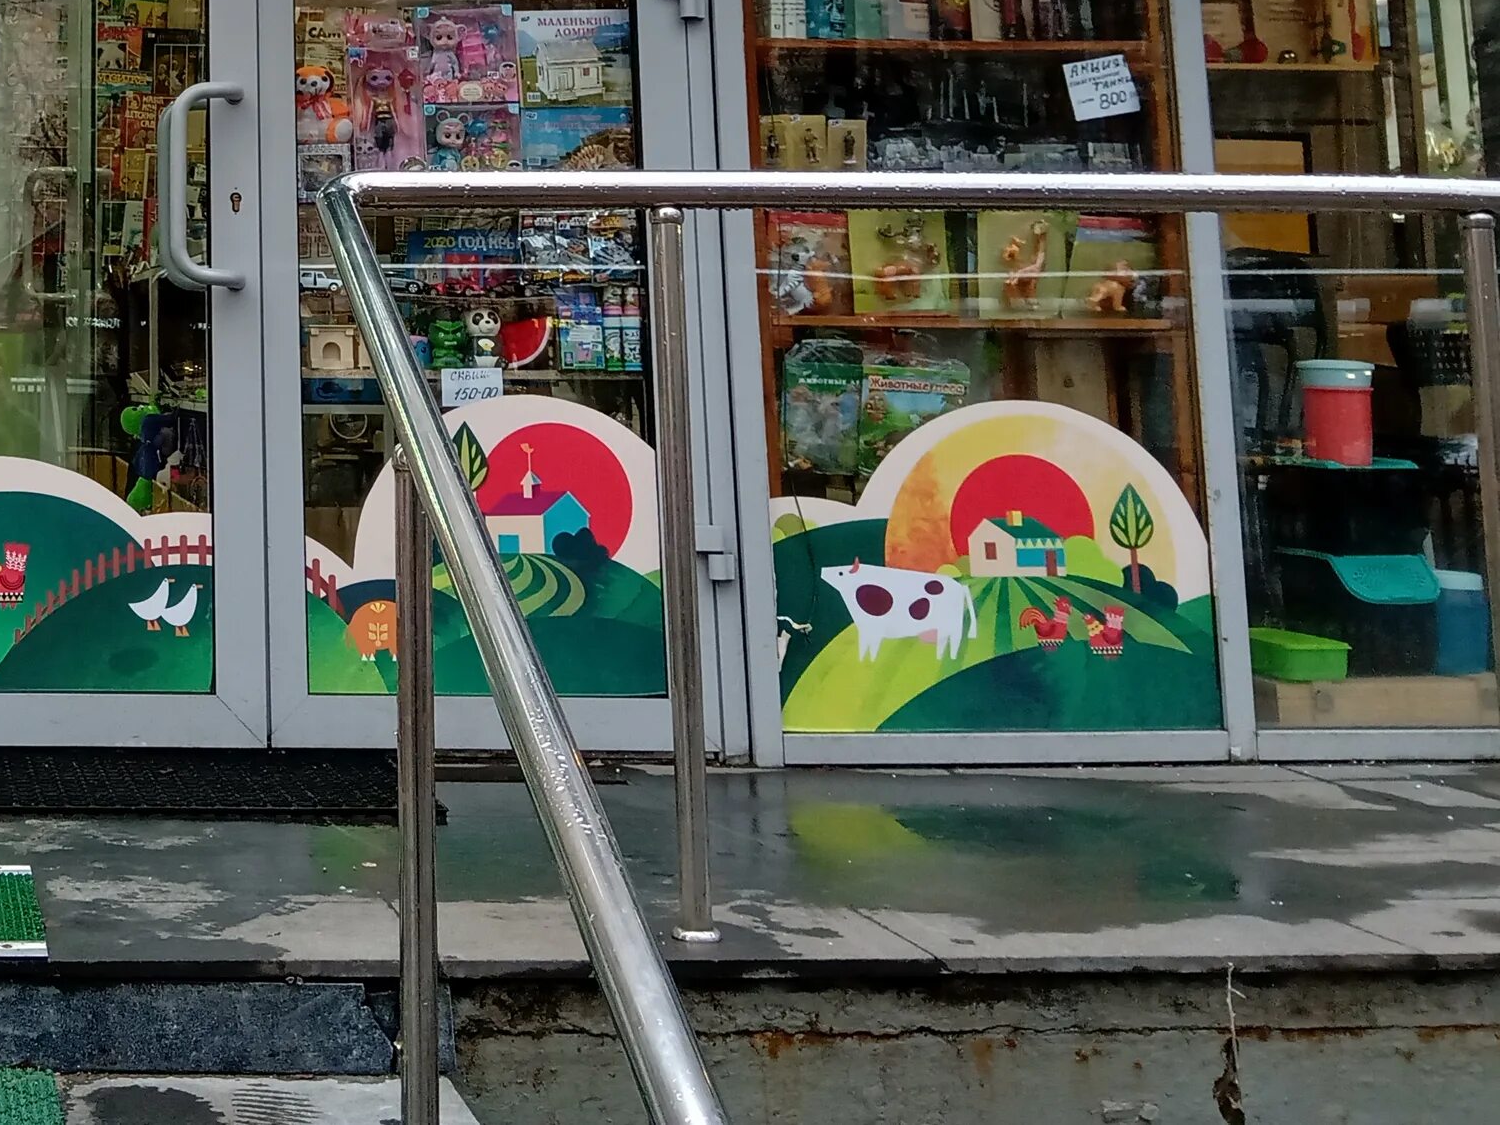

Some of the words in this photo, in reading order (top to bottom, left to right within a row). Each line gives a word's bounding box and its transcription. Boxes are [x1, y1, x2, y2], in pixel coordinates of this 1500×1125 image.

[537, 16, 611, 27] МАЛЕНЬКИЙ
[1100, 91, 1127, 110] 800
[423, 236, 456, 249] 2020
[457, 235, 487, 252] ГОД
[870, 377, 928, 391] Животные
[455, 387, 498, 400] 150-00
